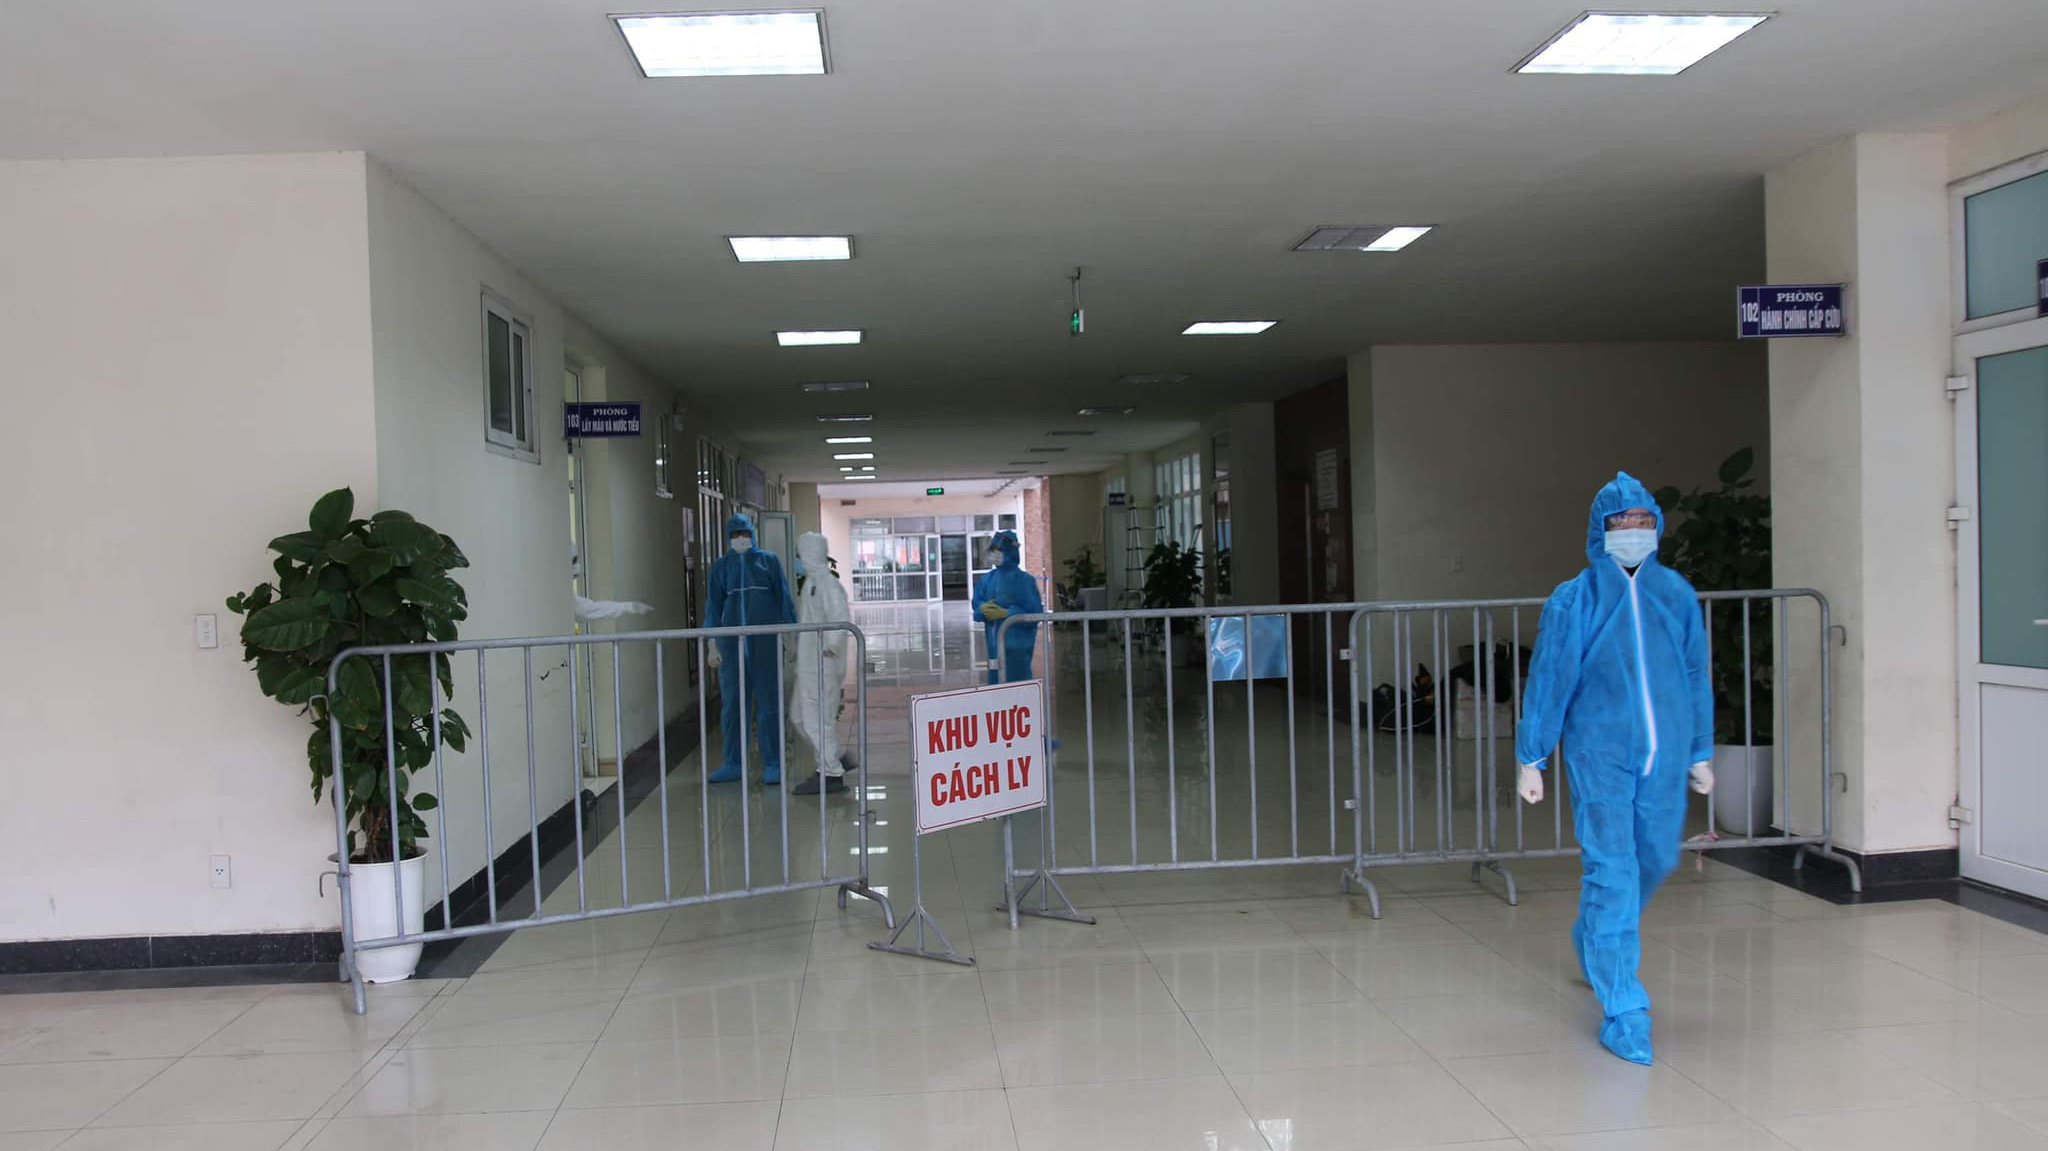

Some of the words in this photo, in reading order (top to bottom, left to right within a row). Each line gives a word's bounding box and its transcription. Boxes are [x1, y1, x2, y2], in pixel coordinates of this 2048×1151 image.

[1776, 290, 1824, 302] PHÒNG
[1741, 302, 1759, 323] 102
[1761, 306, 1782, 330] HÀNH
[1784, 305, 1807, 330] CHÍNH
[1808, 303, 1824, 329] CẤP
[567, 413, 580, 428] 103
[593, 406, 628, 416] PHÒNG
[928, 714, 978, 755] KHU
[985, 704, 1031, 748] VỰC
[930, 762, 1000, 807] CÁCH
[1007, 755, 1032, 791] LY
